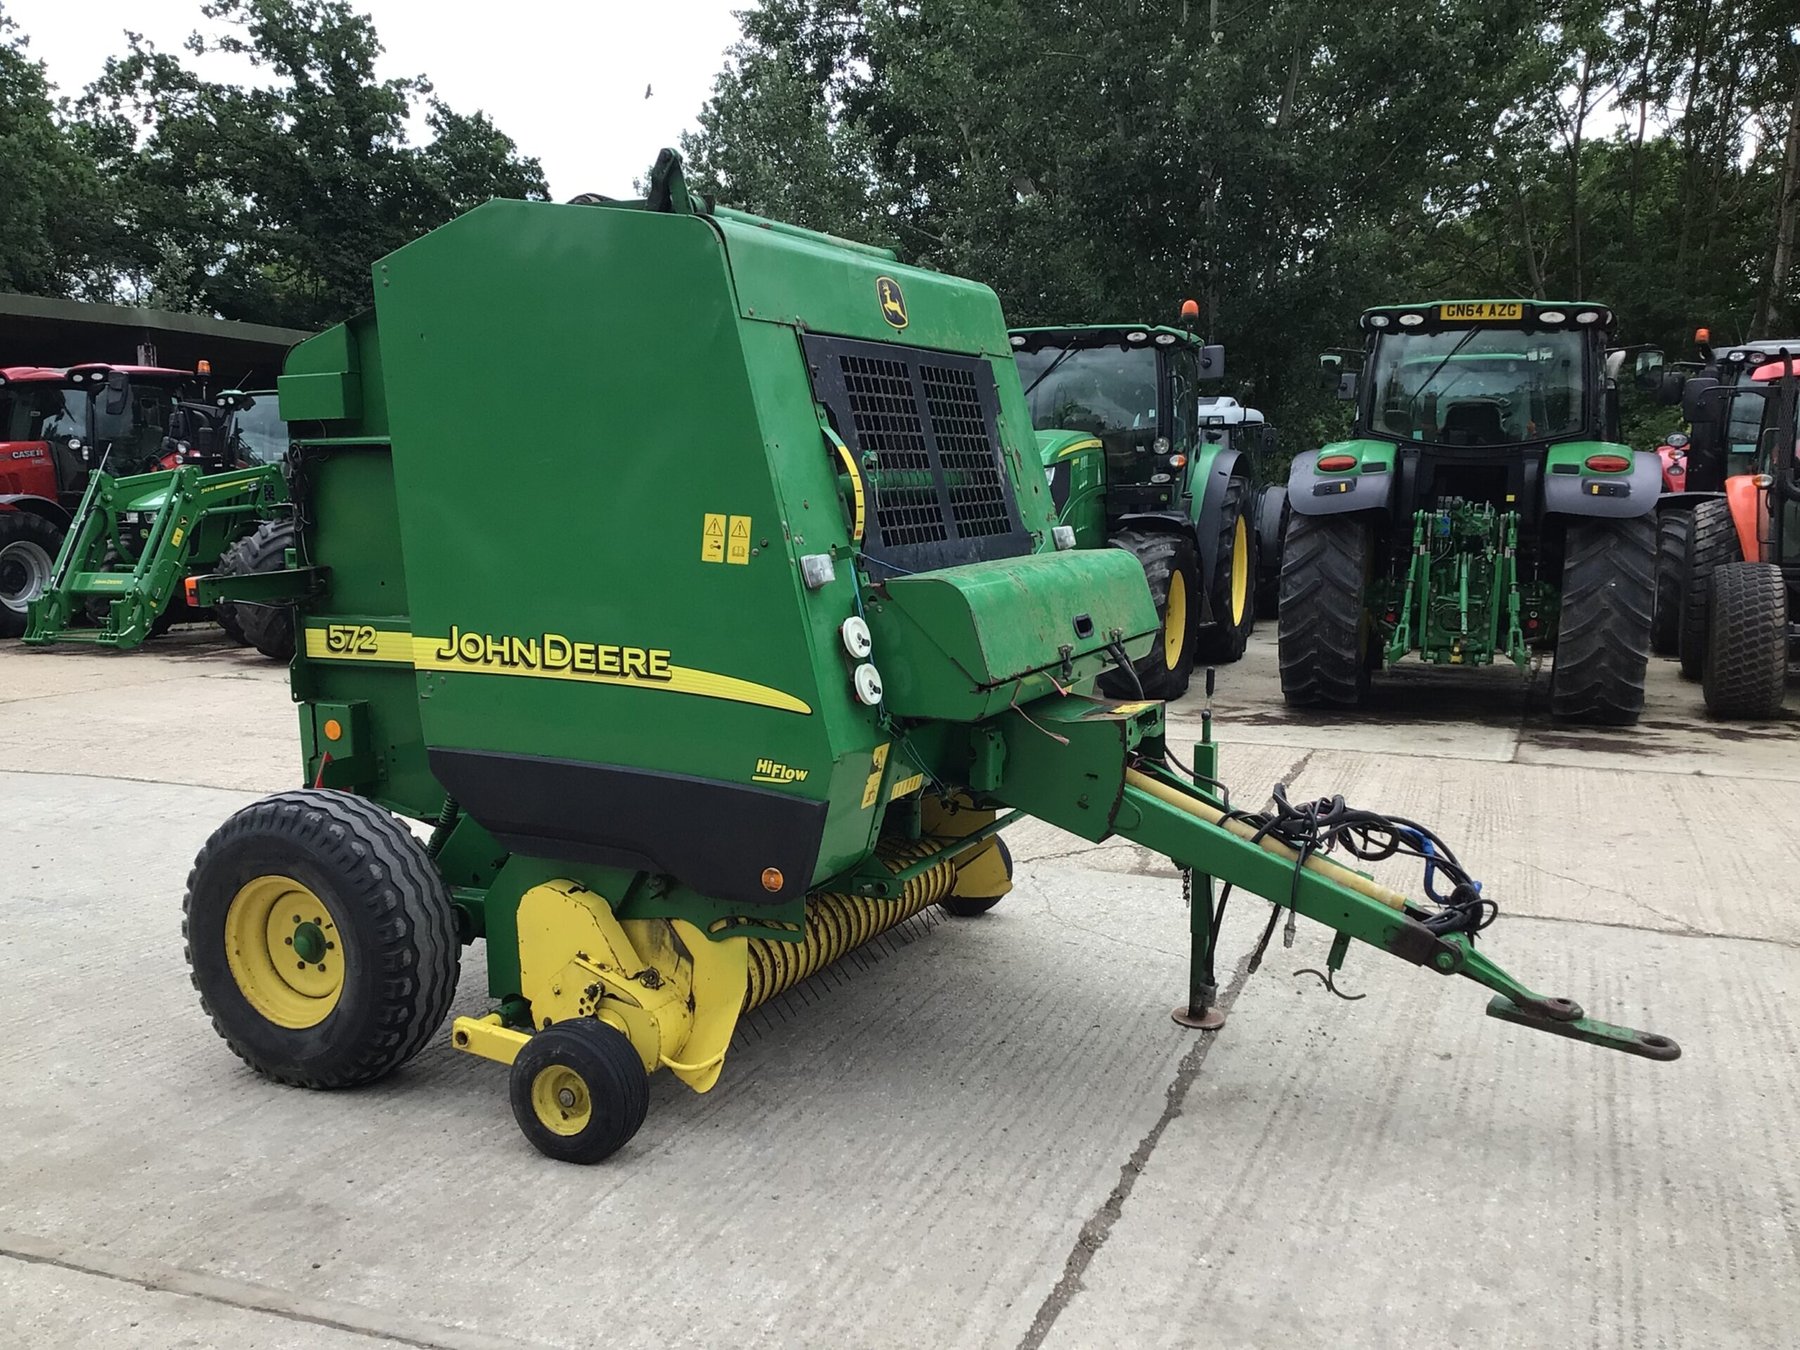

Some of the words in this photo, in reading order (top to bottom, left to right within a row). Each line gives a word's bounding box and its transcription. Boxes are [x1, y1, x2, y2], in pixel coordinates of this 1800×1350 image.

[1447, 304, 1483, 317] GN64
[1488, 304, 1517, 317] AZG
[327, 624, 378, 652] 572
[437, 625, 537, 667] JOHN
[542, 633, 672, 681] DEERE
[755, 757, 809, 782] HiFlow
